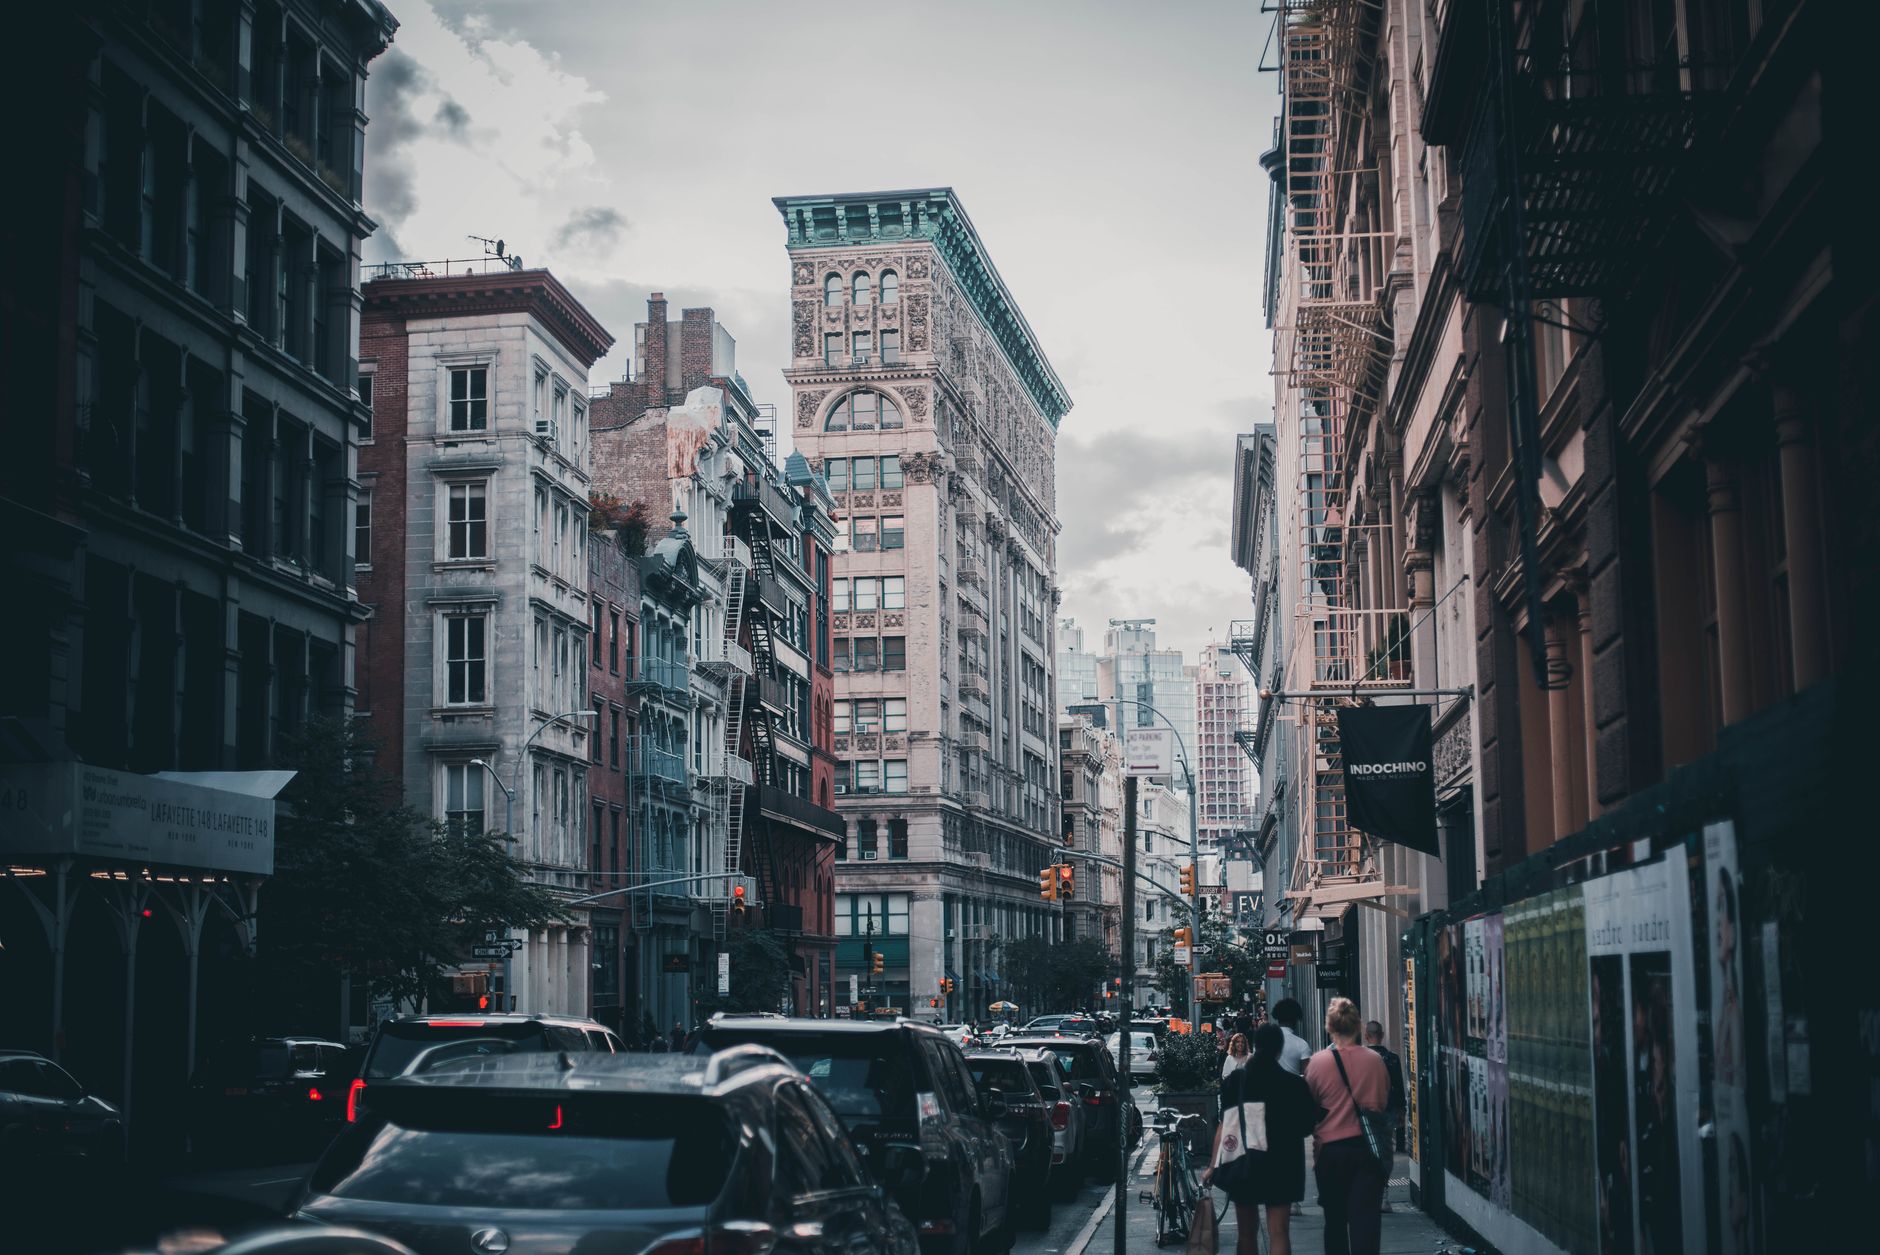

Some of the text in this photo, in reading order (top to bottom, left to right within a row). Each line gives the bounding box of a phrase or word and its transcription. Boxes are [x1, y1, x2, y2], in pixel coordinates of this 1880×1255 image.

[1350, 761, 1426, 775] INDOCHINO
[151, 802, 211, 830] LAFAYETTE 148
[213, 812, 268, 838] LAFAYETTE 148
[1265, 933, 1288, 945] OK
